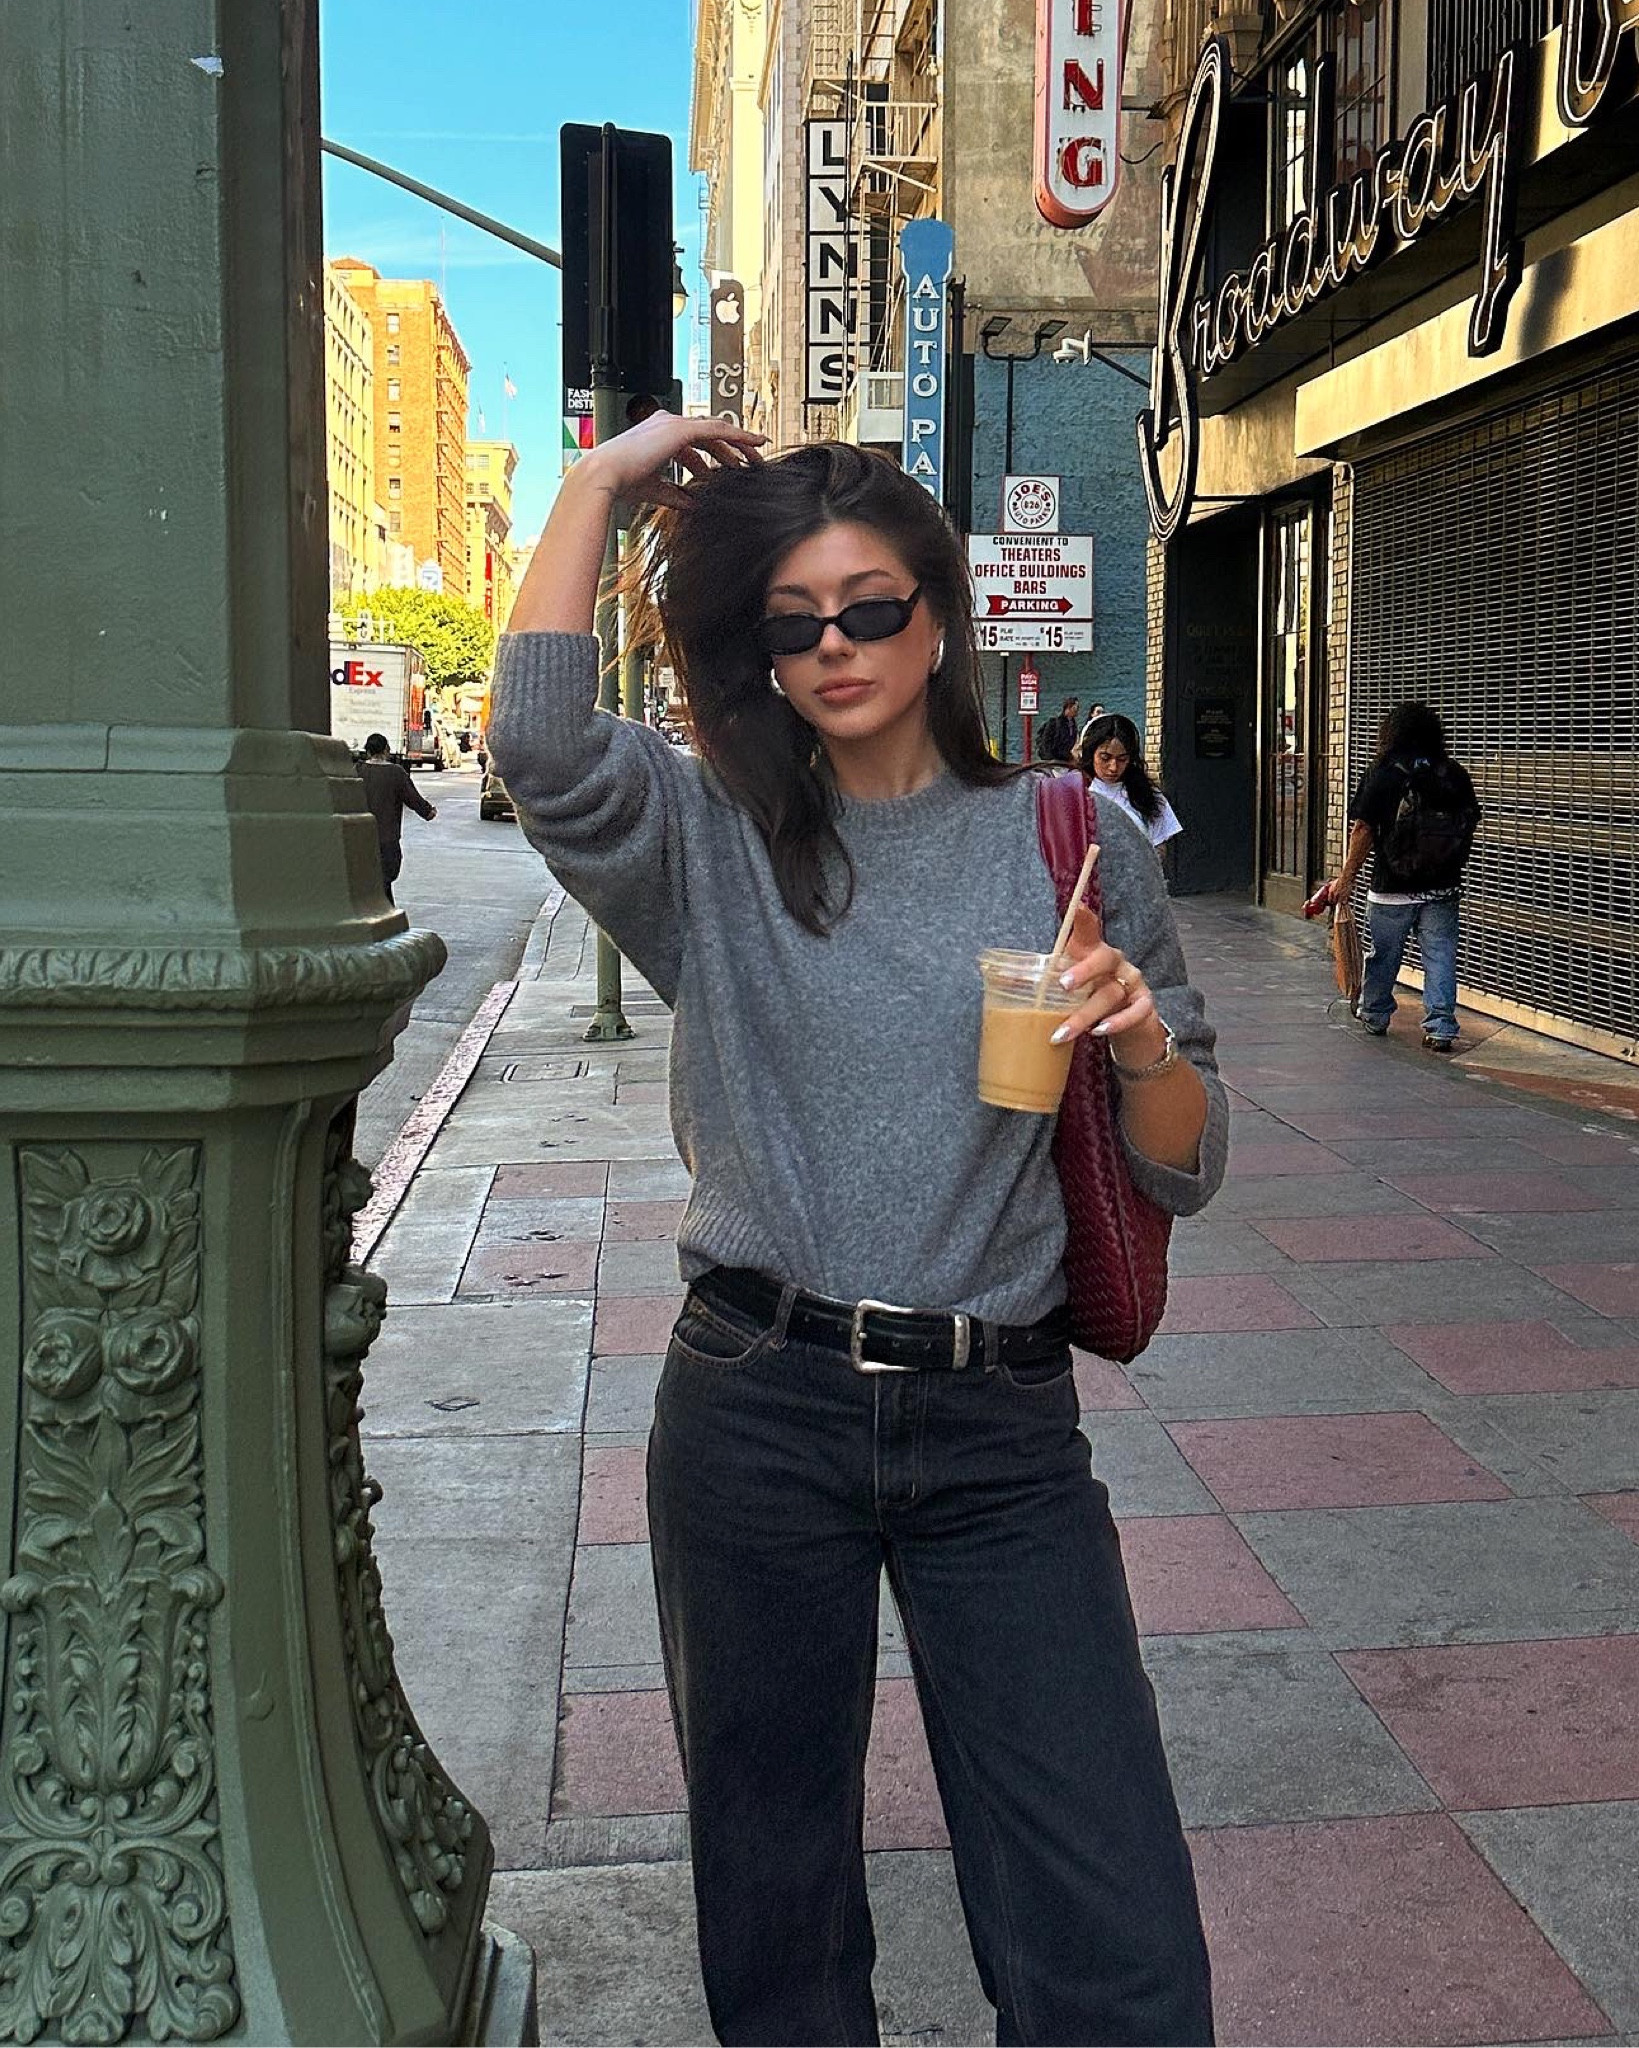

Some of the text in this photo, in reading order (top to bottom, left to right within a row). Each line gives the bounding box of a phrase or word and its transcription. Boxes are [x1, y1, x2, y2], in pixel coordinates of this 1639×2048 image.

[818, 129, 857, 391] LYNNS
[1137, 40, 1515, 541] Broadway
[910, 273, 940, 496] AUTO PA
[568, 388, 594, 398] FASH
[1014, 484, 1051, 501] JOE'S
[993, 537, 1069, 546] CONVENIENT TO
[1001, 548, 1061, 561] THEATERS
[974, 565, 1086, 578] OFFICE BUILDINGS
[1013, 581, 1047, 594] BARS
[1001, 600, 1059, 611] PARKING
[332, 661, 384, 687] dEx
